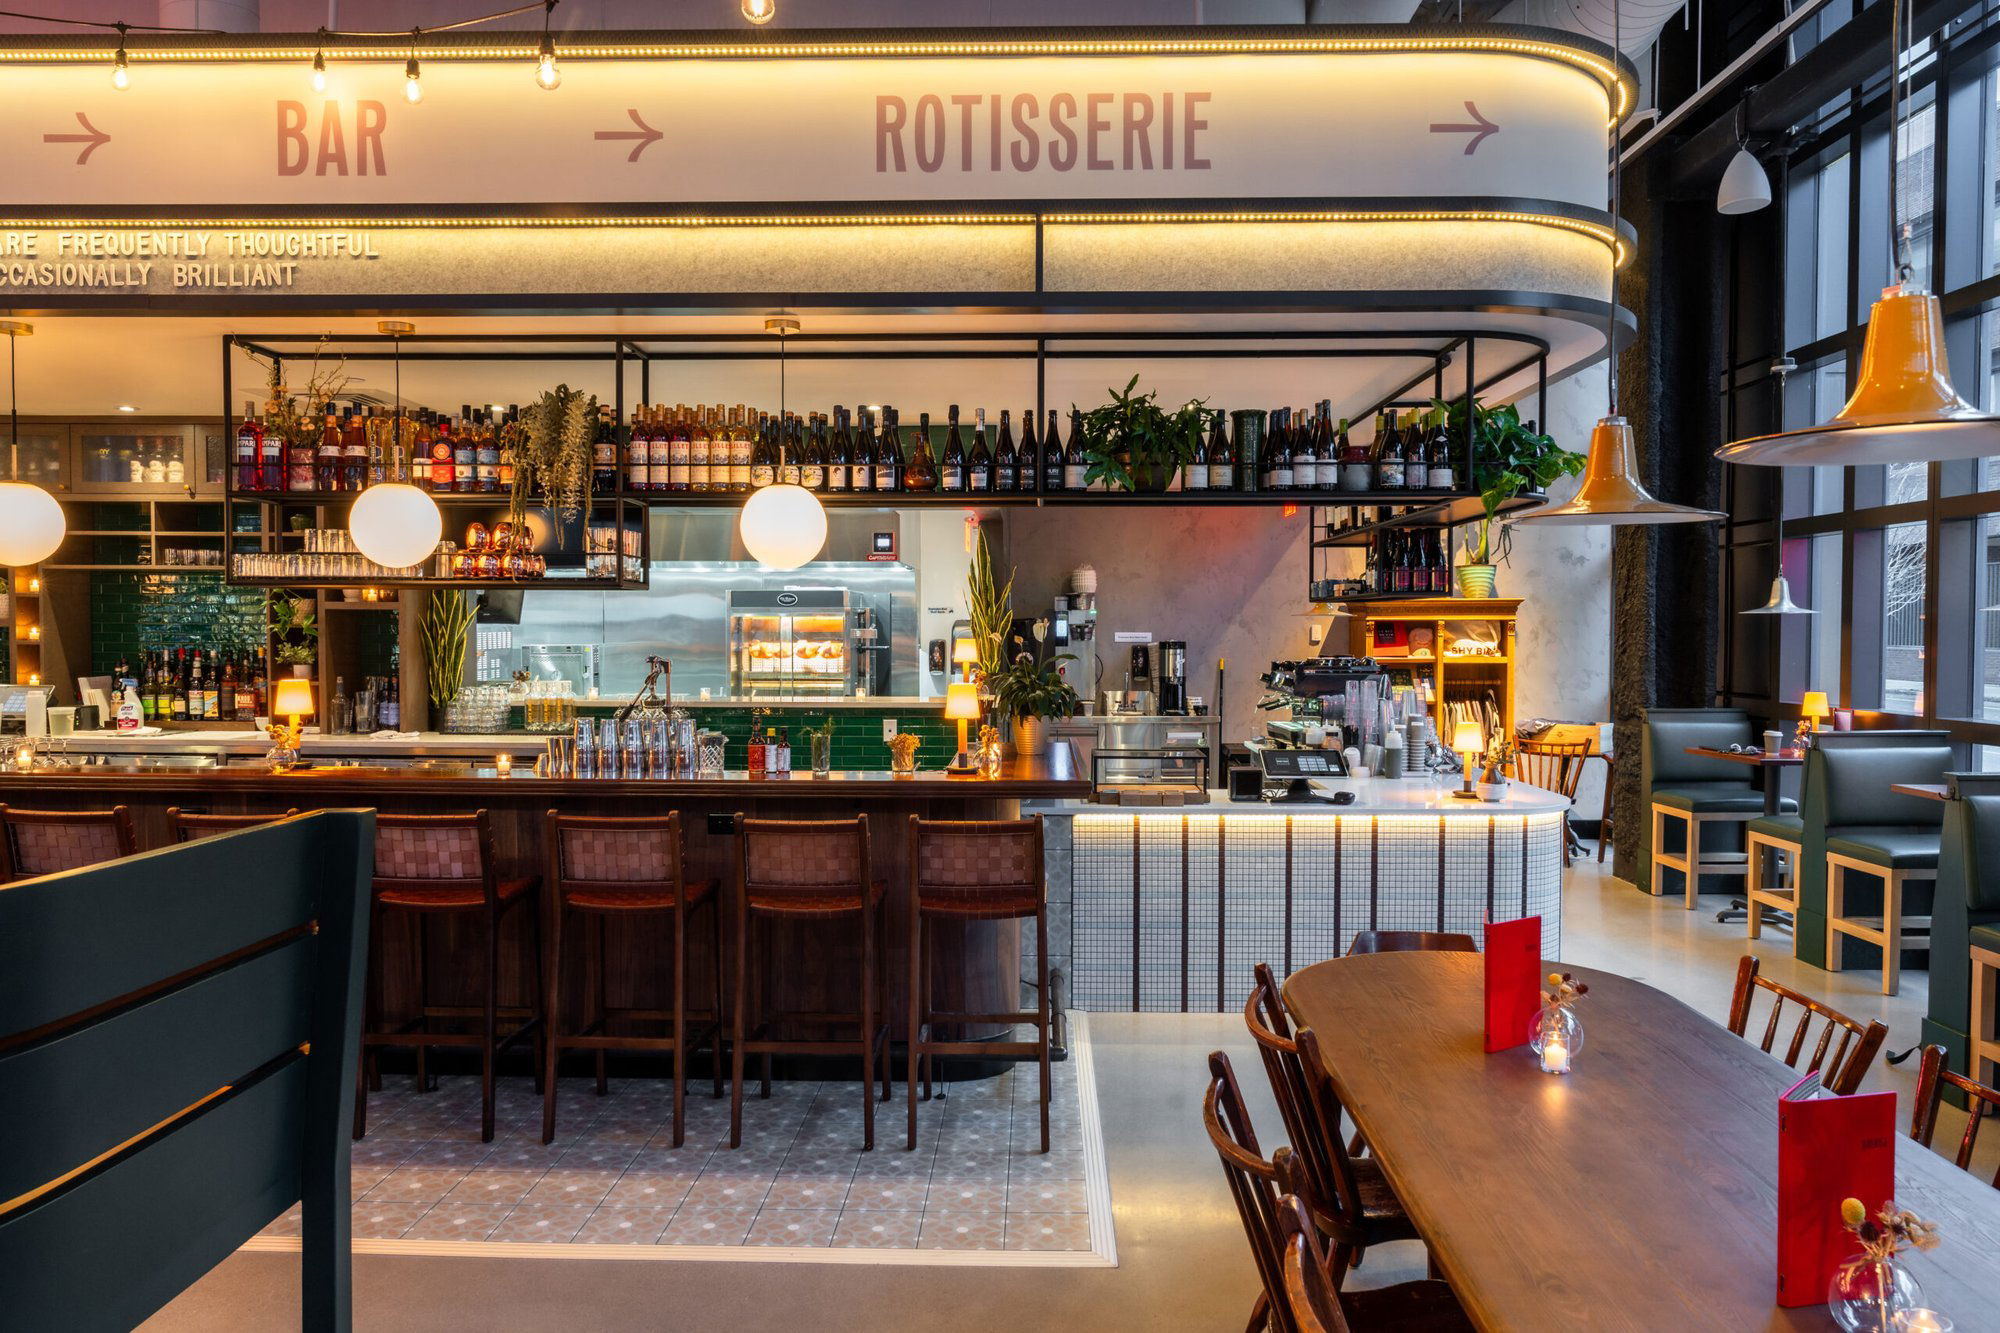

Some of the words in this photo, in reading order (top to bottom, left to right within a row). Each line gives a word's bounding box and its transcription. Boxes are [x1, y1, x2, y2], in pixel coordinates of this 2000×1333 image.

[277, 99, 387, 177] BAR
[876, 92, 1212, 173] ROTISSERIE
[0, 232, 38, 257] RE
[58, 232, 211, 257] FREQUENTLY
[224, 232, 379, 257] THOUGHTFUL
[173, 262, 297, 287] BRILLIANT
